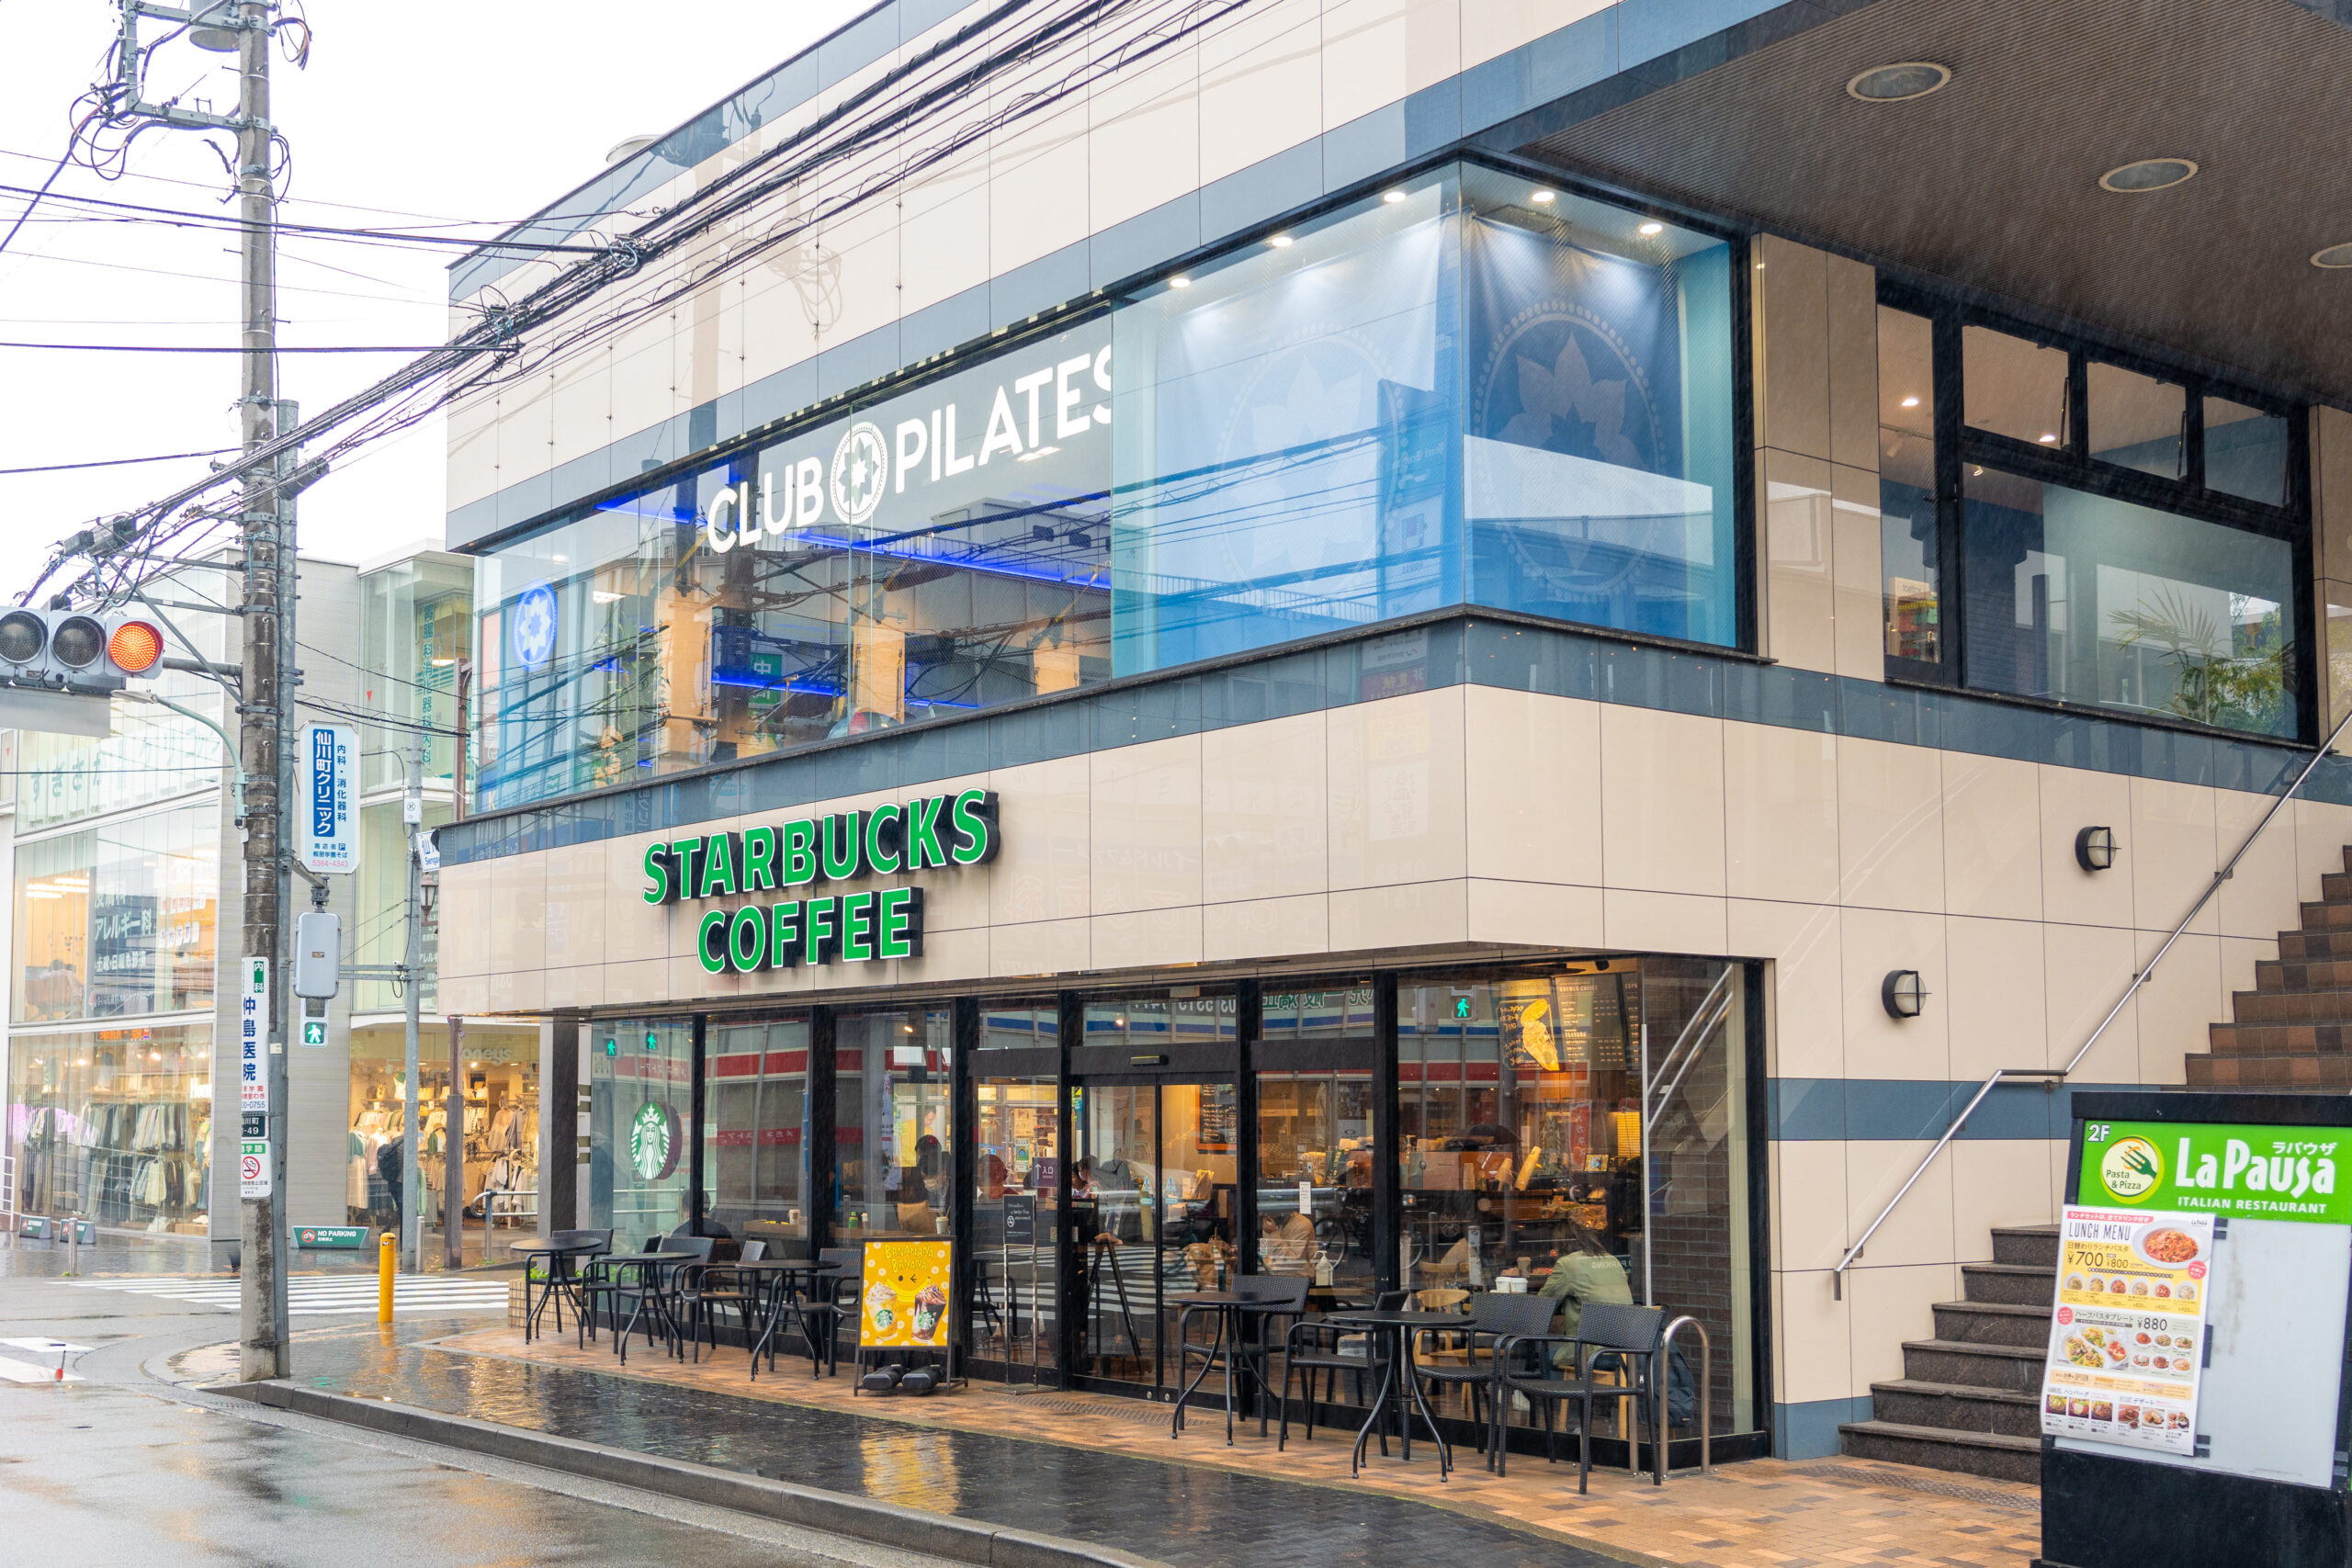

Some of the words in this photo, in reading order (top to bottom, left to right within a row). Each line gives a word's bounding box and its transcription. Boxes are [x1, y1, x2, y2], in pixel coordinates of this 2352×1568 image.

[707, 457, 824, 554] CLUB
[315, 731, 333, 835] 仙川町クリニック
[336, 745, 346, 822] 内科・消化器科
[642, 787, 988, 906] STARBUCKS
[697, 887, 912, 975] COFFEE
[254, 963, 264, 993] 内科
[463, 1047, 512, 1066] oneys
[243, 1126, 259, 1134] -49
[2087, 1123, 2110, 1142] 2F
[1042, 1166, 1054, 1175] 入口
[2106, 1169, 2130, 1179] Pasta
[2111, 1180, 2118, 1189] &
[2119, 1180, 2142, 1190] Pizza
[2177, 1196, 2232, 1209] ITALIAN
[2235, 1199, 2327, 1214] RESTAURANT
[2068, 1222, 2099, 1238] LUNCH
[2103, 1224, 2132, 1241] MENU
[2068, 1242, 2129, 1252] 日替わりランチパスタ
[892, 1258, 927, 1273] BANANA
[2067, 1251, 2104, 1268] ¥700
[2075, 1311, 2134, 1322] ハーフパスタプレート
[2137, 1317, 2167, 1331] ¥880
[2064, 1387, 2089, 1396] ハンバーグ
